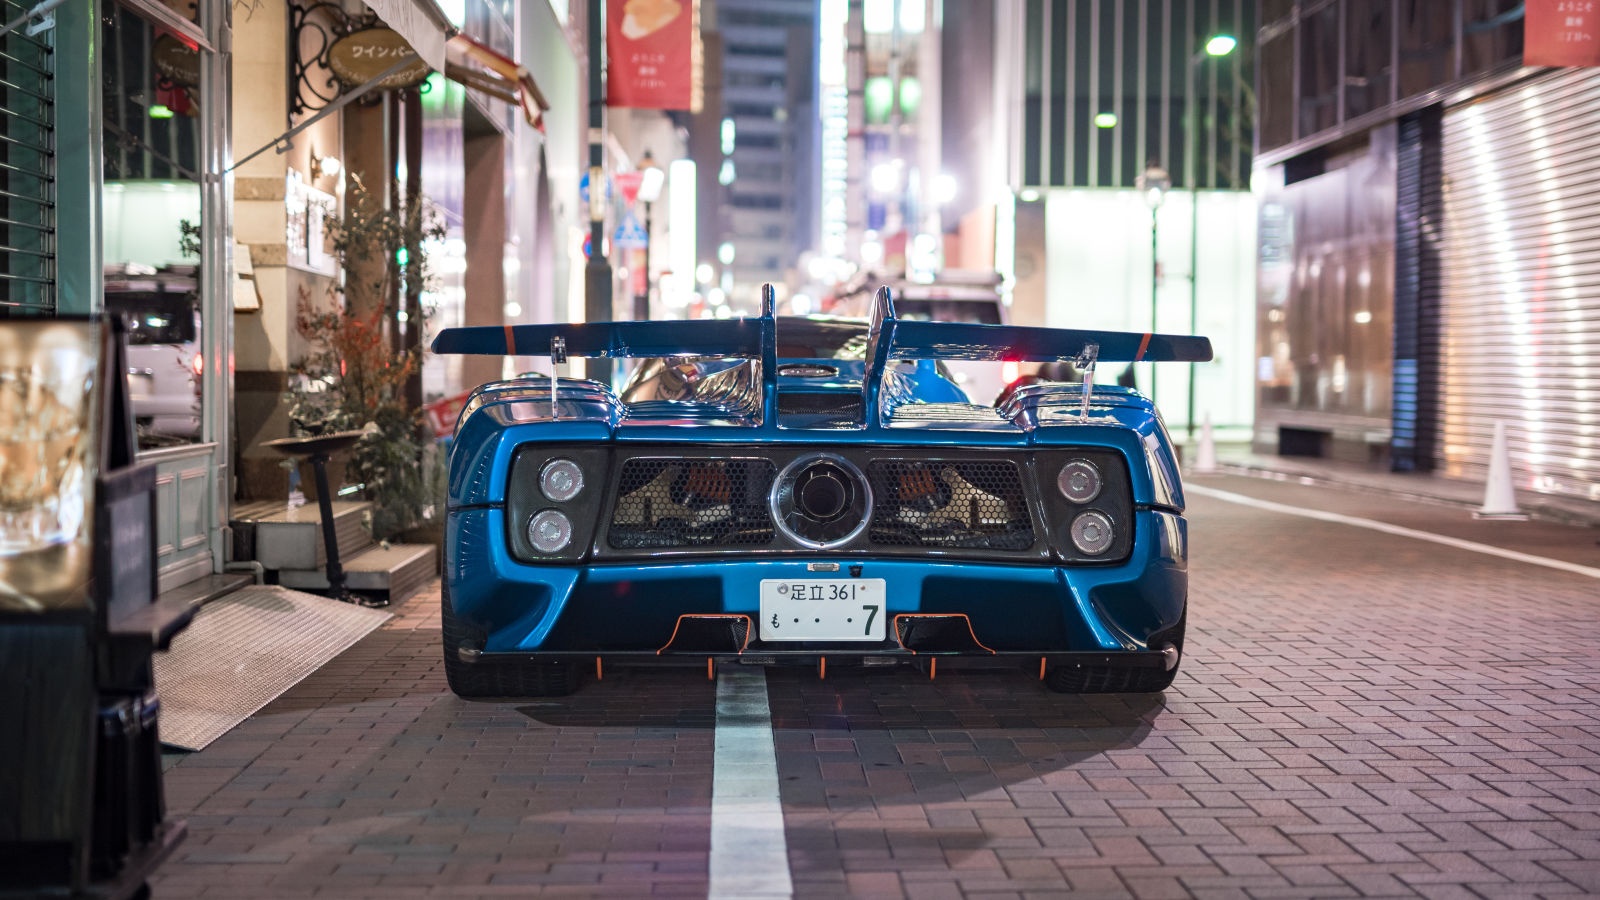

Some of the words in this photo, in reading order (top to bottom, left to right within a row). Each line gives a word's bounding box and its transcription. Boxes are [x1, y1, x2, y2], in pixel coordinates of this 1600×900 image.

[352, 45, 415, 58] ワインバー
[791, 584, 825, 601] 足立
[829, 584, 856, 600] 361
[771, 613, 780, 629] も
